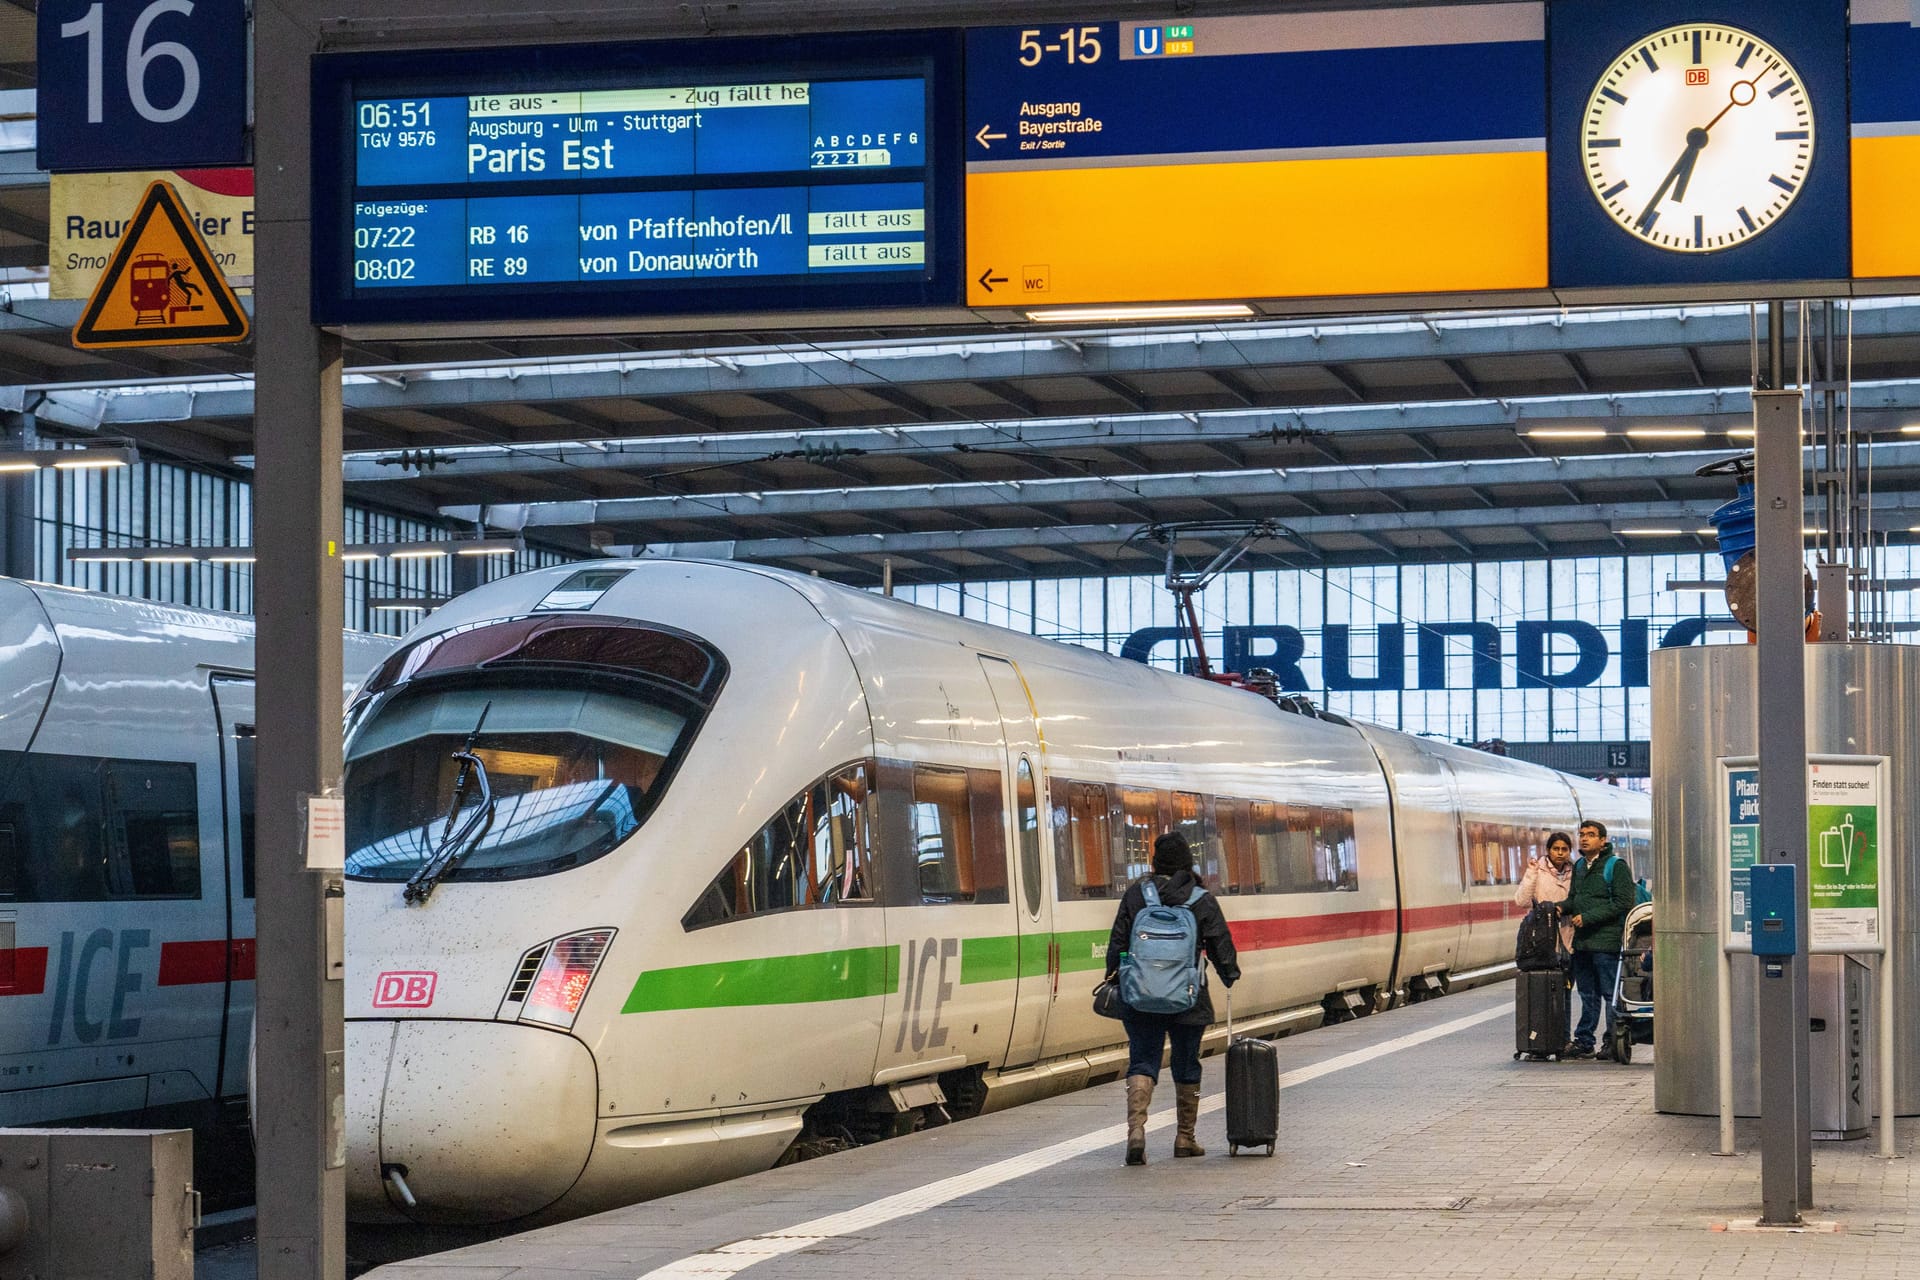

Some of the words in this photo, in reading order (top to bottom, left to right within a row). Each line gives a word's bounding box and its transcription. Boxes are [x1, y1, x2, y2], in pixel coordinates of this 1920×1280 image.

[1019, 27, 1102, 67] 5-15
[1138, 29, 1158, 54] U
[61, 0, 200, 123] 16
[1688, 71, 1706, 84] DB
[509, 97, 543, 110] aus
[685, 87, 719, 106] Zug
[1020, 101, 1081, 118] Ausgang
[360, 102, 431, 129] 06:51
[469, 119, 543, 140] Augsburg
[568, 117, 598, 133] Ulm
[623, 113, 702, 133] Stuttgart
[1019, 117, 1103, 137] Bayerstraße
[361, 133, 391, 148] TGV
[398, 131, 436, 147] 9576
[814, 136, 825, 148] A
[831, 135, 840, 147] B
[846, 135, 855, 147] C
[862, 134, 872, 146] D
[877, 133, 887, 145] E
[893, 133, 902, 145] F
[909, 132, 918, 144] G
[1020, 141, 1036, 150] Exit
[1041, 140, 1066, 150] Sortie
[468, 142, 546, 174] Paris
[563, 139, 614, 171] Est
[816, 153, 825, 165] 2
[831, 153, 840, 165] 2
[847, 152, 855, 164] 2
[355, 202, 429, 218] Folgezüge:
[354, 226, 416, 249] 07:22
[470, 226, 496, 245] RB
[506, 225, 529, 244] 16
[580, 224, 617, 241] von
[877, 213, 912, 227] aus
[354, 258, 416, 281] 08:02
[470, 259, 496, 277] RE
[504, 257, 528, 276] 89
[580, 256, 617, 274] von
[629, 247, 758, 272] Donauwörth
[877, 246, 912, 260] aus
[1025, 278, 1044, 290] WC
[1611, 752, 1627, 766] 15
[1812, 779, 1833, 789] Finden
[1833, 781, 1848, 789] statt
[47, 927, 151, 1045] ICE
[380, 977, 428, 1002] DB
[895, 937, 958, 1053] ICE
